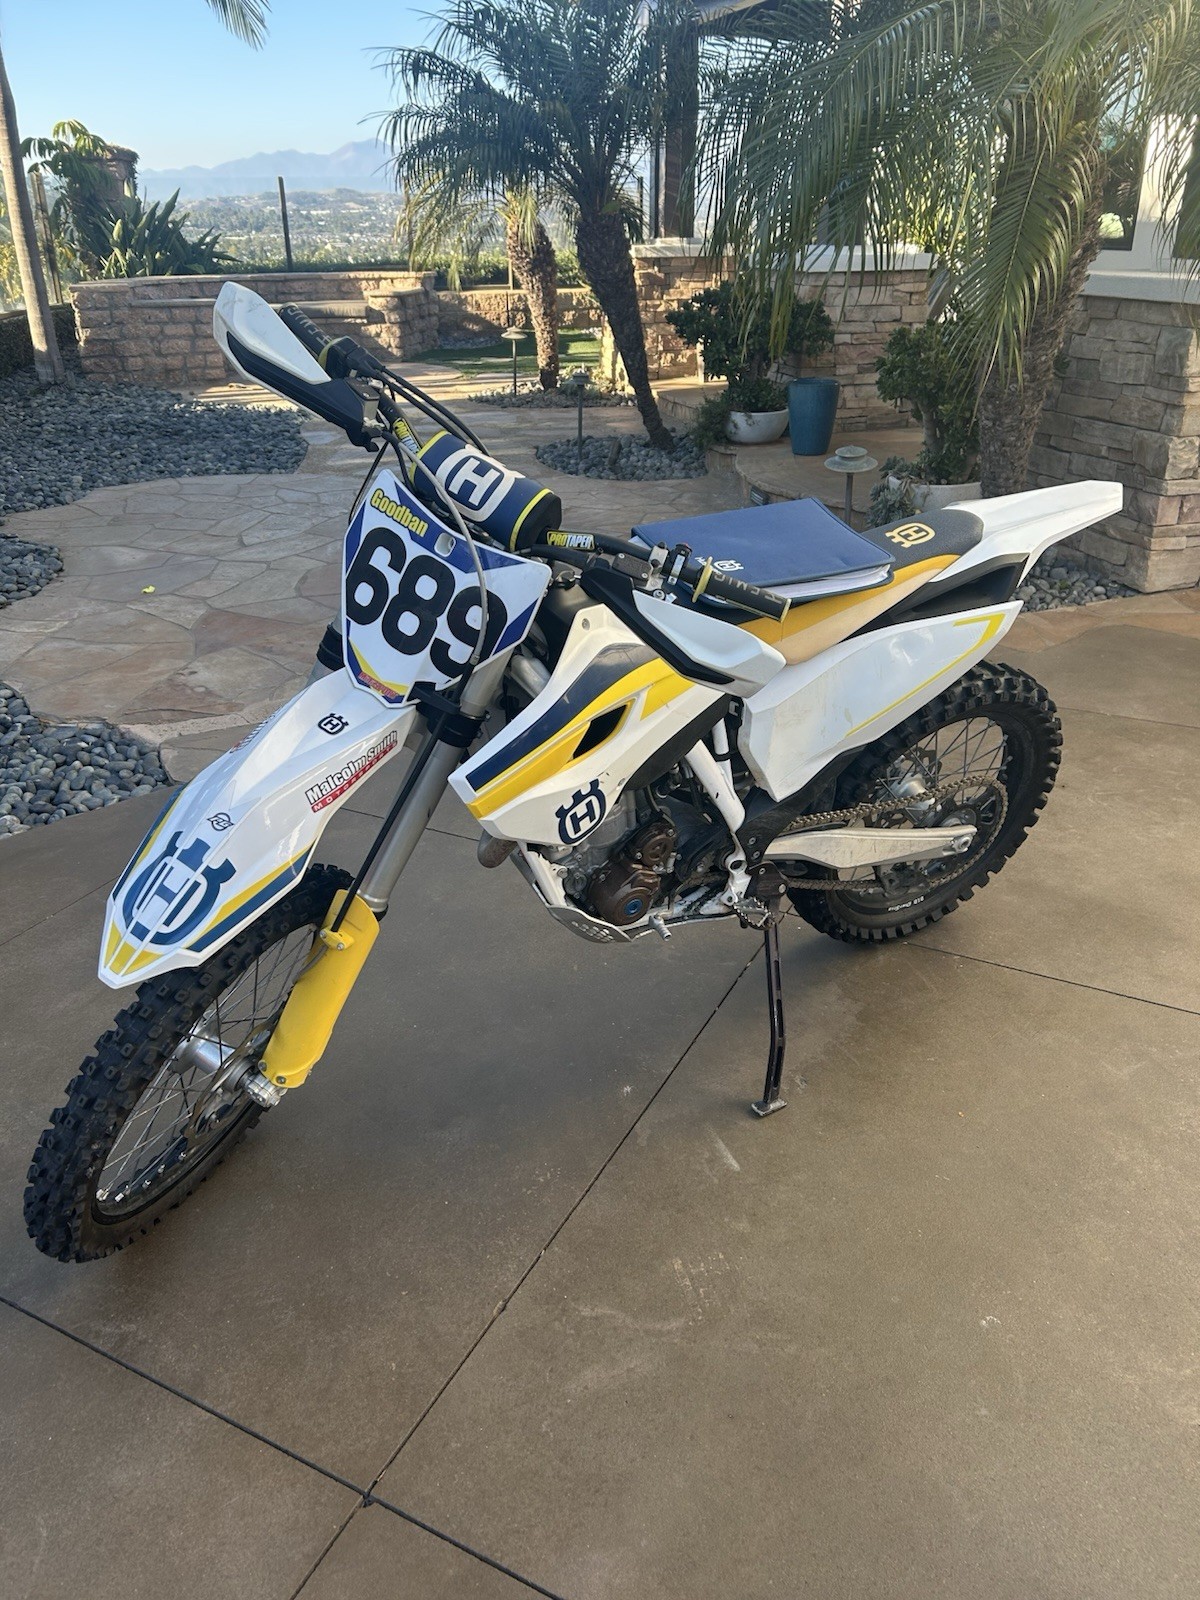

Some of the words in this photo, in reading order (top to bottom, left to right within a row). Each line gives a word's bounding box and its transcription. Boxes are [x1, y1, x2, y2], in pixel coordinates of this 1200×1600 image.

[393, 420, 419, 454] PROTAP
[370, 488, 429, 538] Goodban
[549, 532, 592, 550] PROTAPER
[345, 526, 508, 679] 689
[304, 755, 367, 805] Malcolm
[366, 730, 398, 760] Smith
